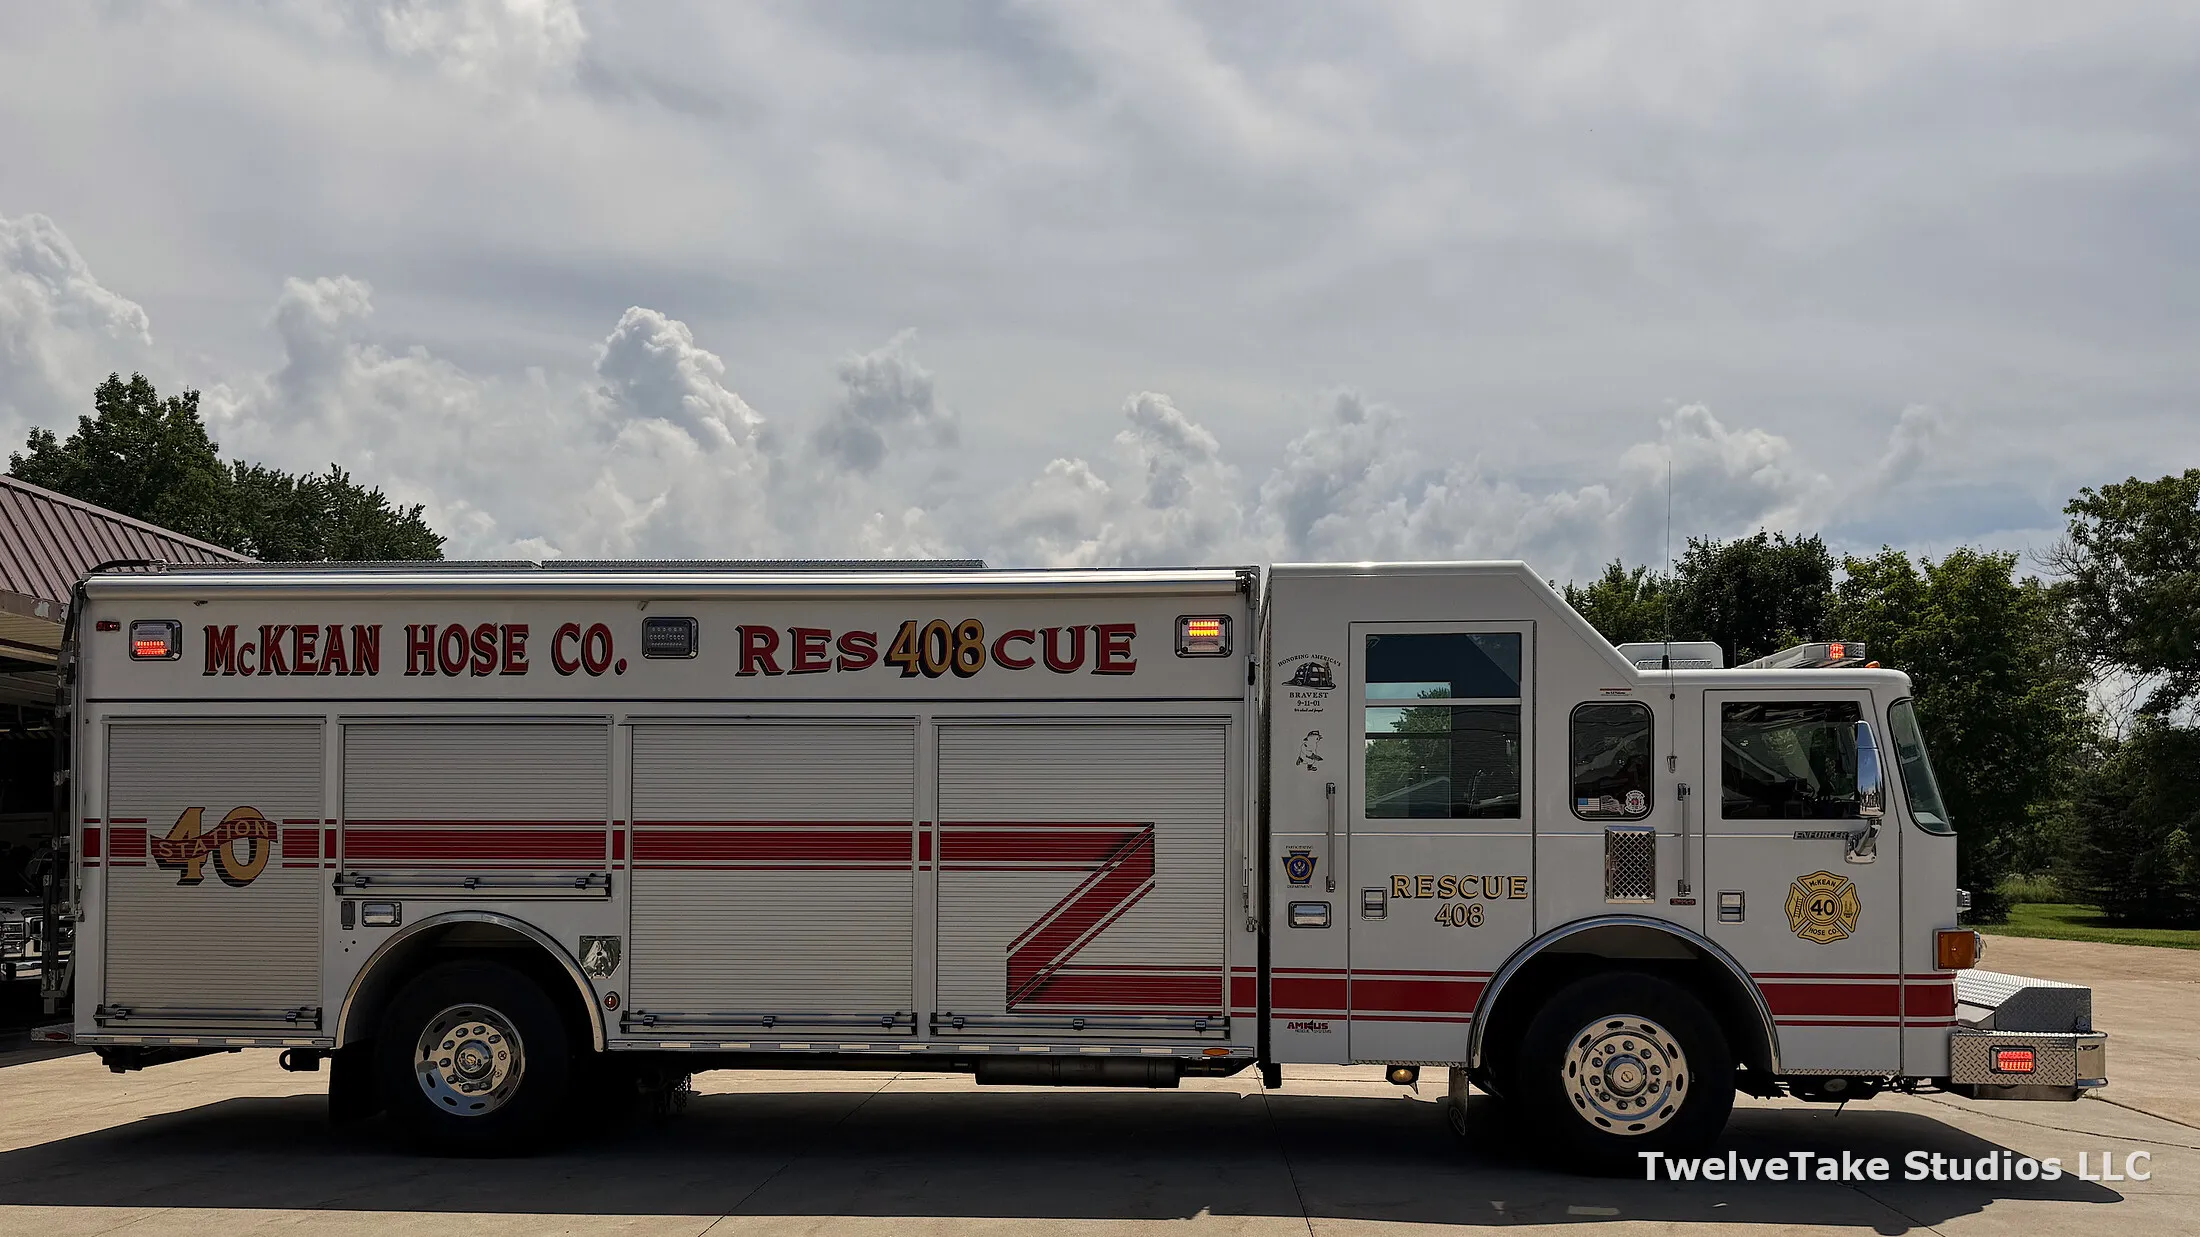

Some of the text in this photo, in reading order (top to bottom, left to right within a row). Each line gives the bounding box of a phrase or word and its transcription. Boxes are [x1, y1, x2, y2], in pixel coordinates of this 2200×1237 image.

[202, 622, 629, 678] McKEAN HOSE CO.
[1277, 653, 1309, 667] HONORING
[1297, 699, 1320, 707] 9-11-01
[158, 819, 269, 859] STATION
[1795, 831, 1849, 840] ENFORCER
[156, 805, 271, 888] 40
[1390, 874, 1529, 900] RESCUE
[1809, 879, 1837, 888] McKEAN
[1434, 902, 1485, 928] 408
[1810, 899, 1836, 916] 40
[1808, 927, 1826, 936] HOSE
